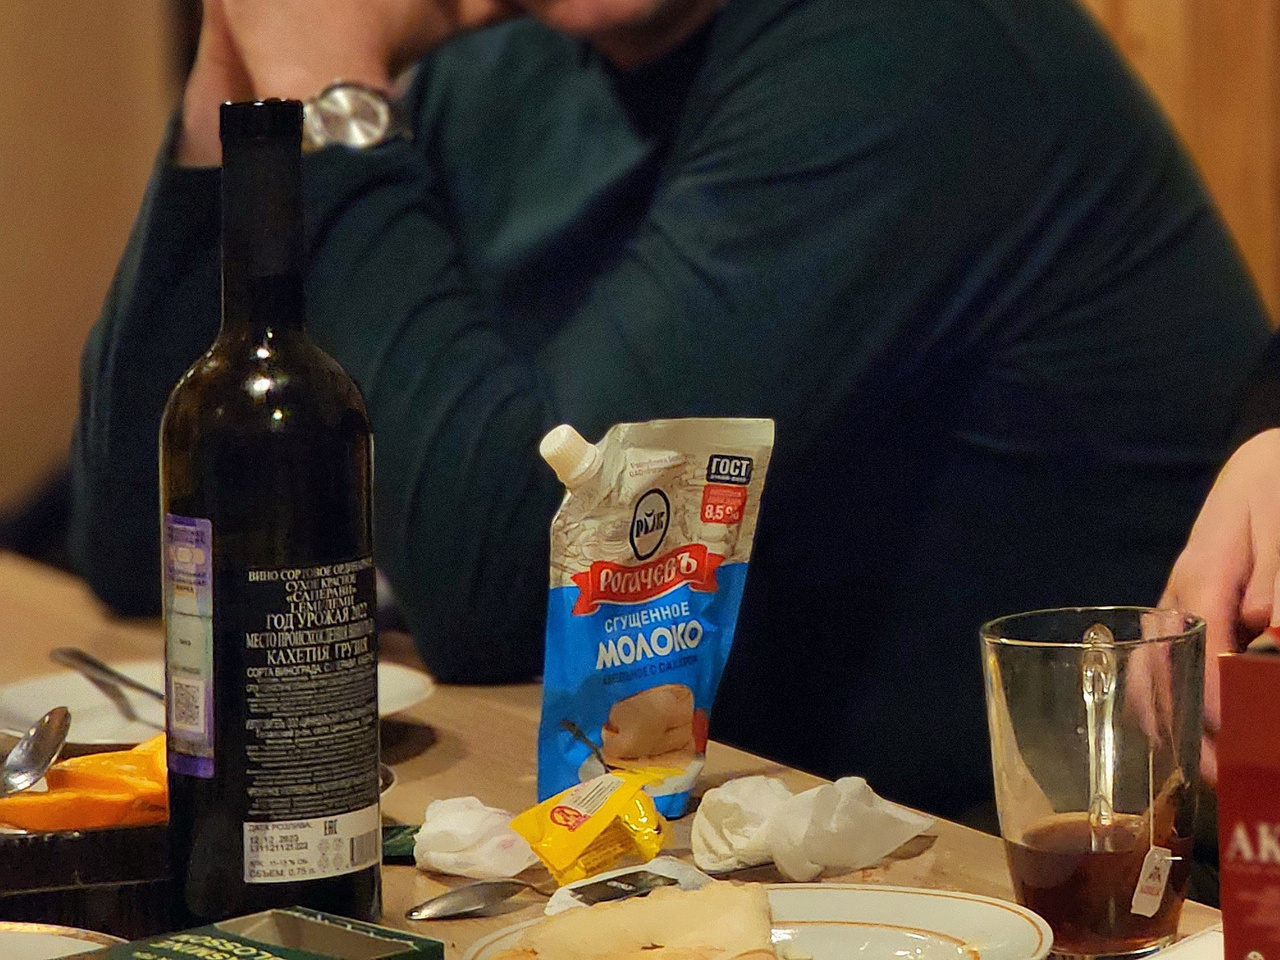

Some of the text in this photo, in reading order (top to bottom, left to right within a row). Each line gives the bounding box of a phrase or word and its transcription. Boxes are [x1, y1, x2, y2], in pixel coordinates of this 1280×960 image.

[711, 457, 750, 477] ГОСТ
[266, 614, 295, 631] ГОД
[297, 606, 350, 627] УРОЖАЯ
[605, 601, 690, 633] СГУЩЕННОЕ
[246, 632, 277, 649] МЕСТО
[596, 620, 703, 670] МОЛОКО
[267, 645, 331, 665] КАХЕТИЯ
